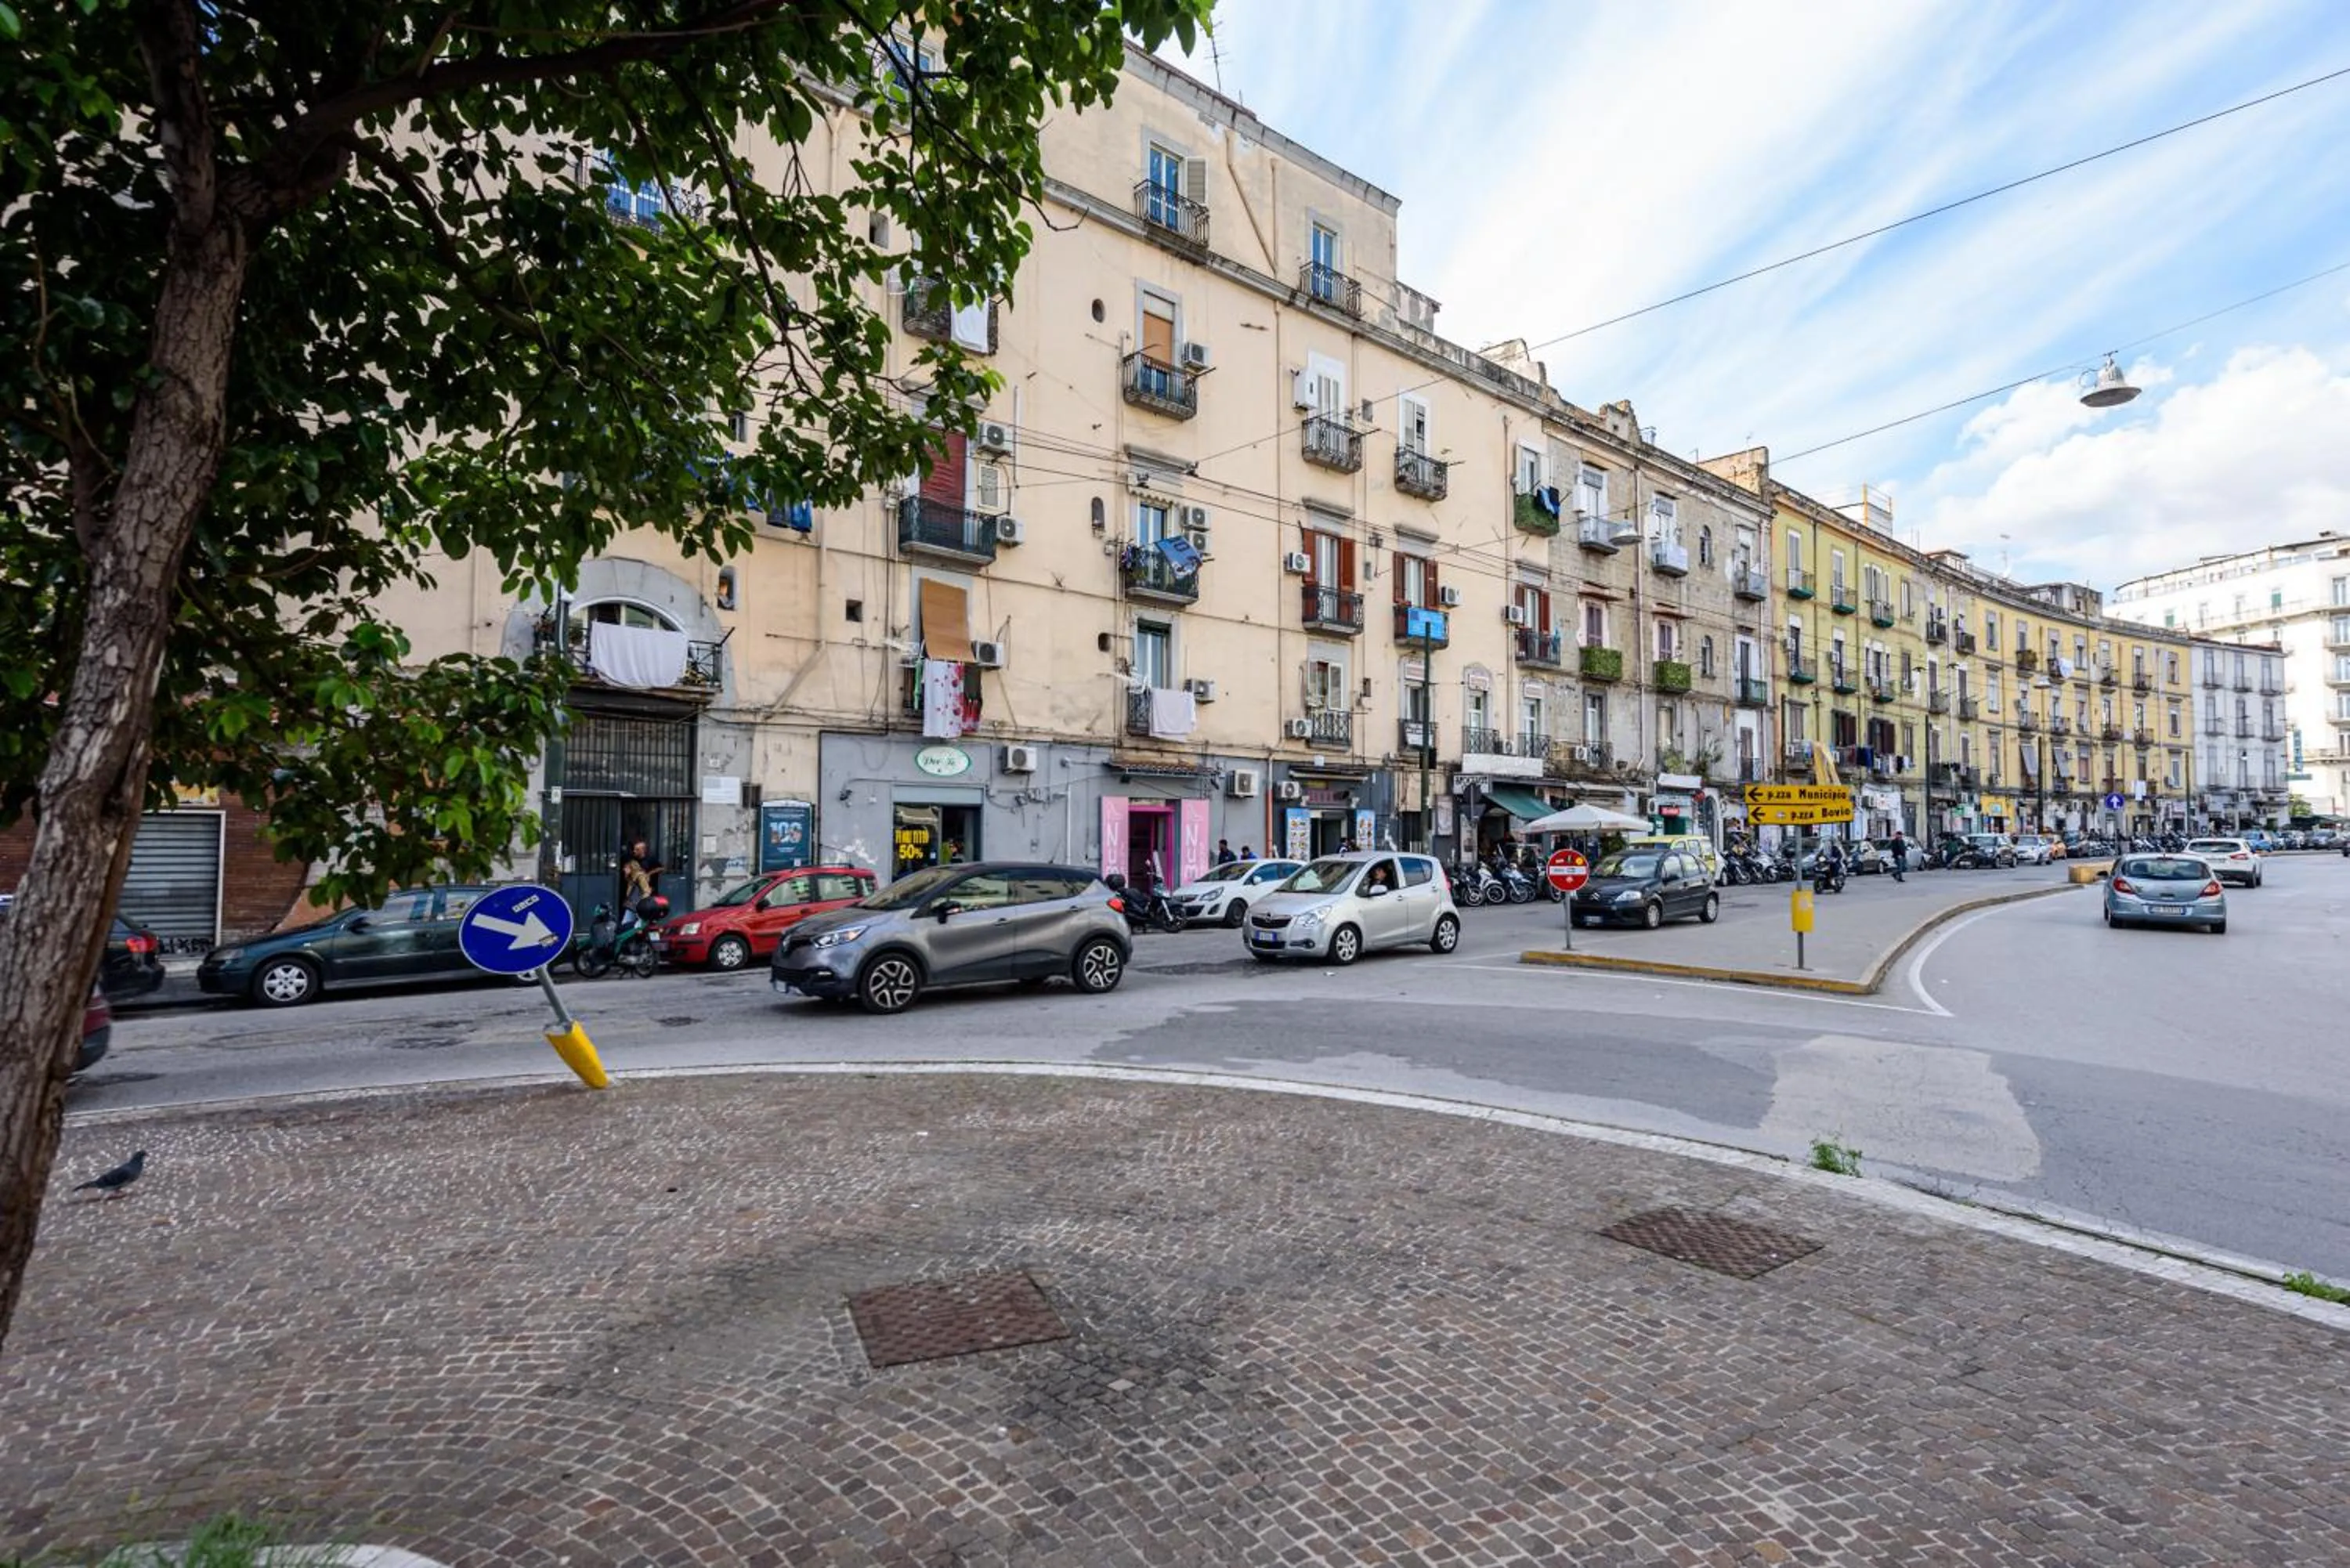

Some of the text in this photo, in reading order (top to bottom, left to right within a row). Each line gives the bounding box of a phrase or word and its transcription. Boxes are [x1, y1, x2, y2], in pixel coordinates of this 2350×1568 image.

[1767, 789, 1846, 800] p.zza Municipio
[1791, 807, 1849, 820] p.zza Bovio
[898, 844, 924, 859] 50%
